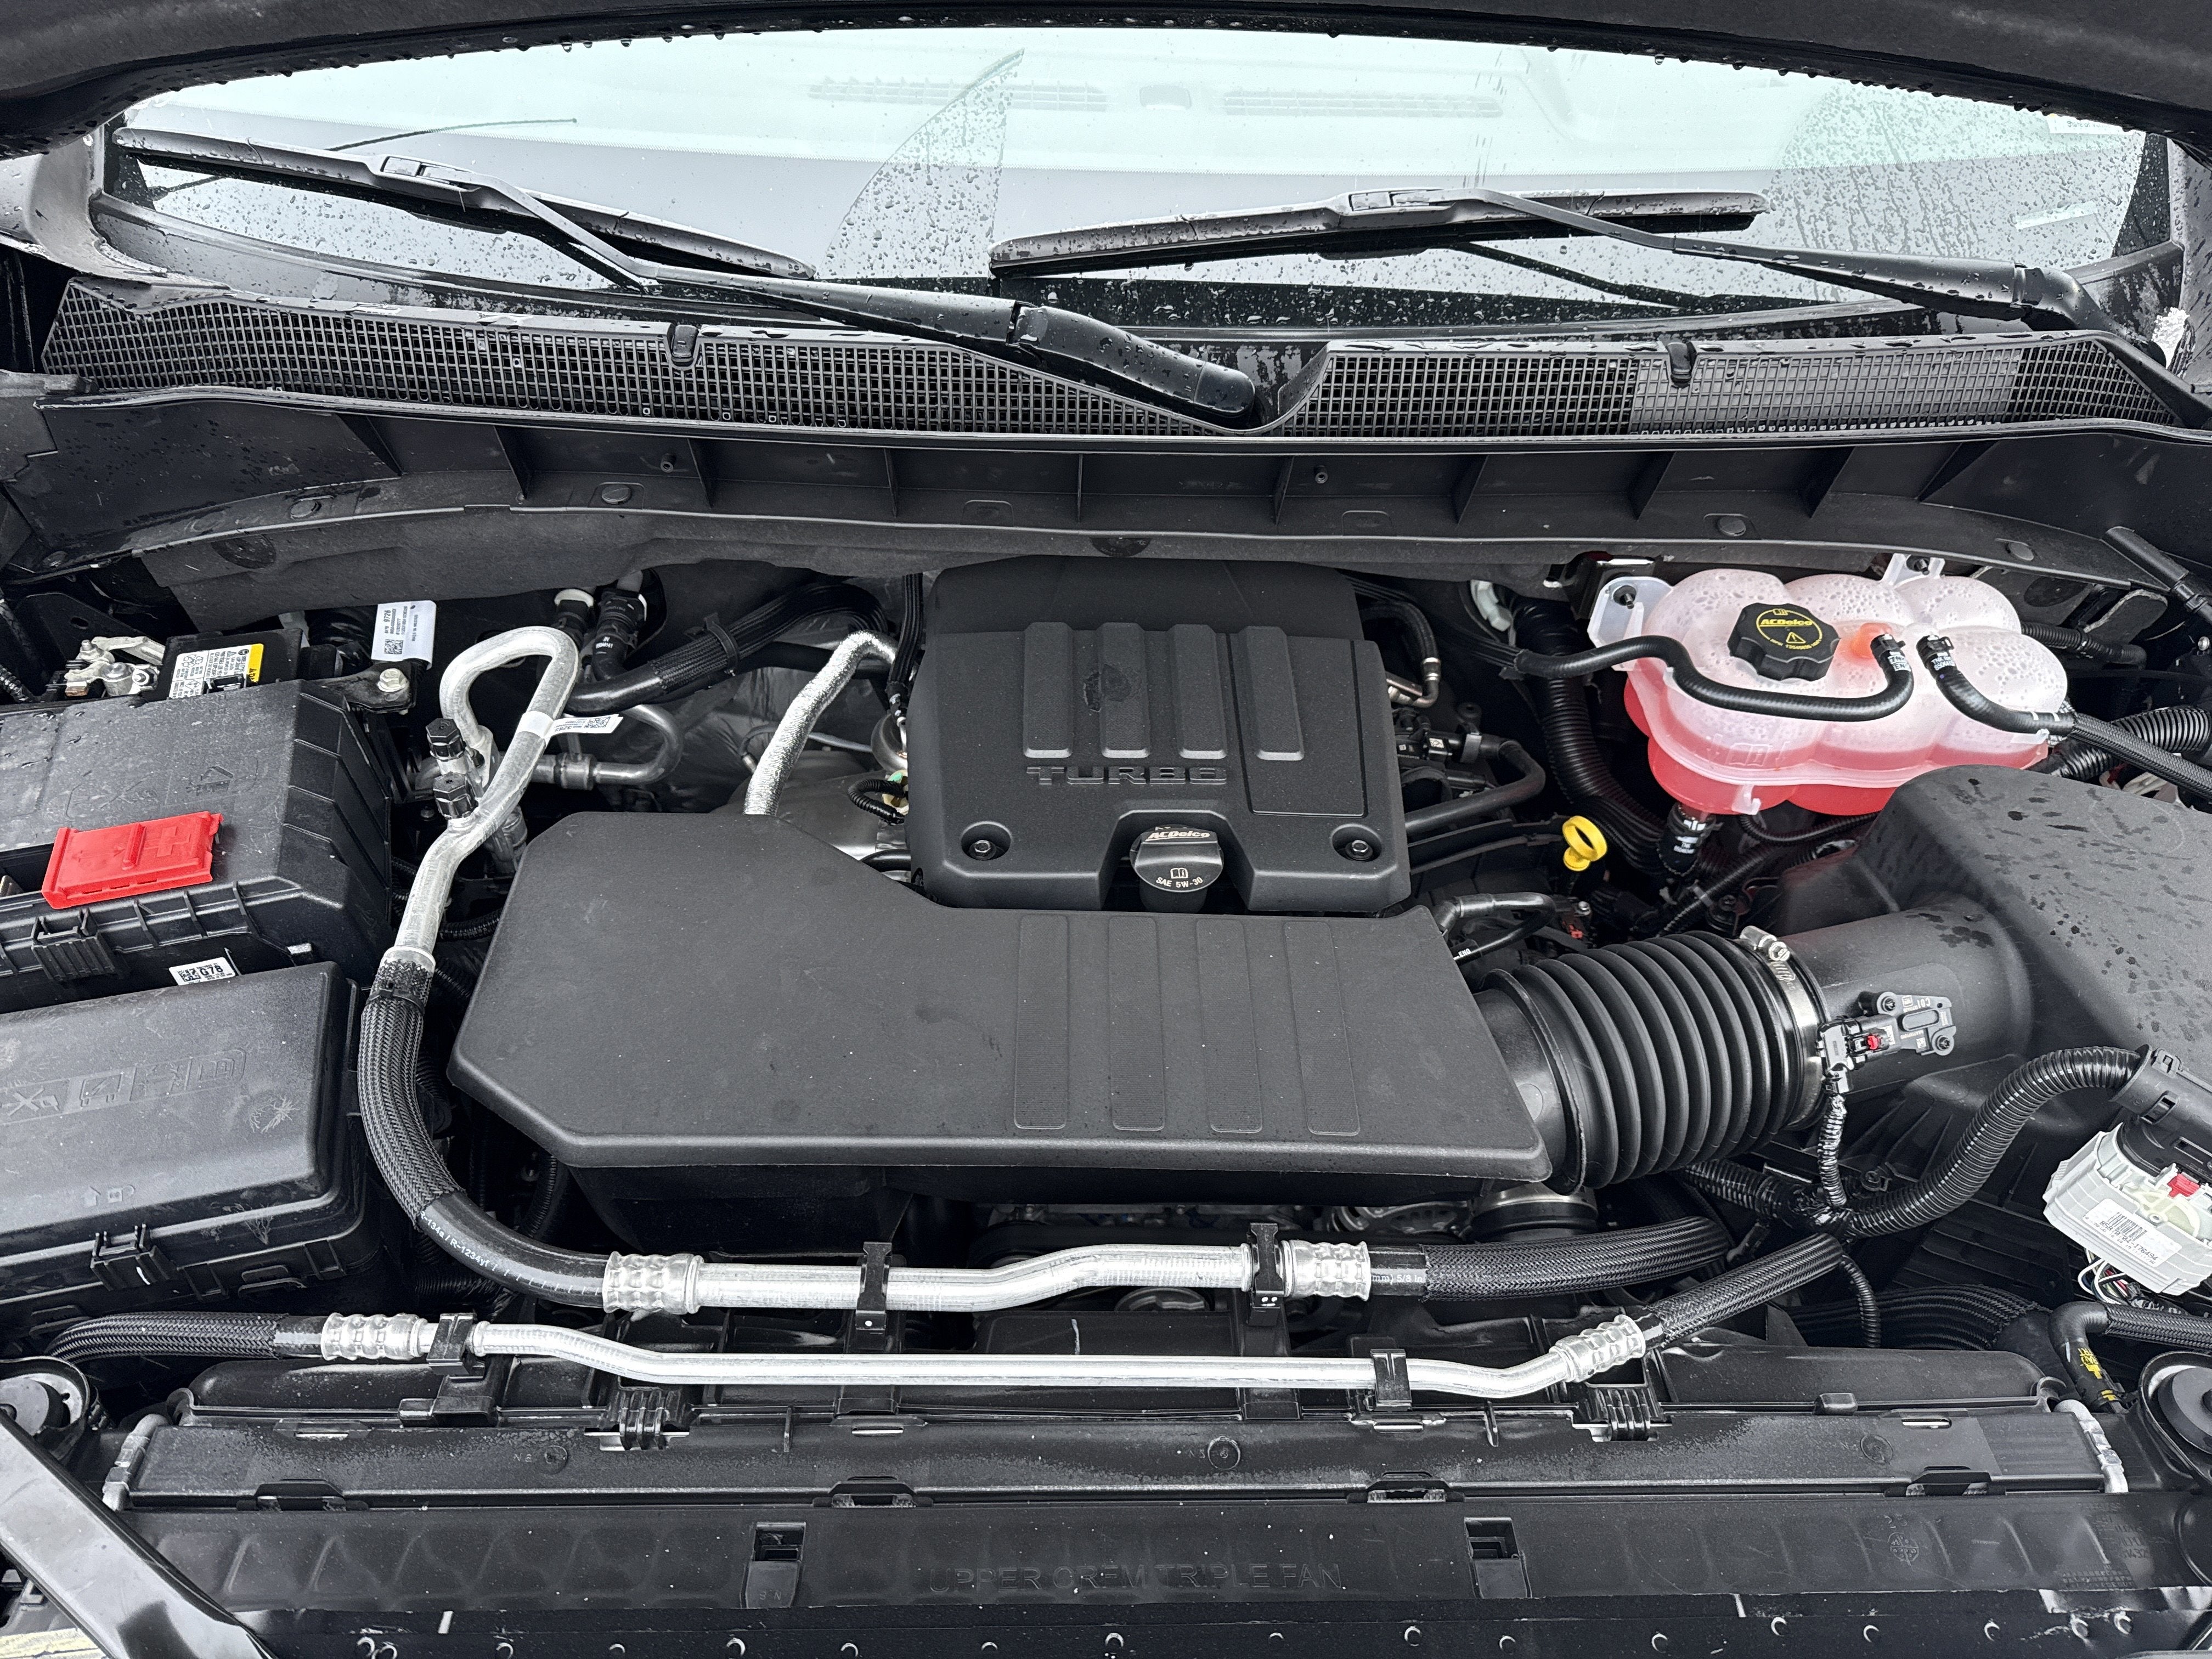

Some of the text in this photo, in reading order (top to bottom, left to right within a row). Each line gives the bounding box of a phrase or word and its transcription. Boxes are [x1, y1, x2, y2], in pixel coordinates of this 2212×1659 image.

[383, 610, 391, 622] 9726
[1026, 767, 1227, 785] TURBO
[1147, 830, 1211, 840] ACDelco
[1155, 877, 1204, 888] SAE 5W-30
[199, 964, 224, 977] G78
[420, 1210, 445, 1239] R-134a
[449, 1238, 490, 1268] R-1234yf
[1396, 1274, 1412, 1283] 5/8
[930, 1567, 1041, 1593] UPPER
[1153, 1563, 1270, 1589] TRIPLE
[1279, 1563, 1344, 1589] FAN
